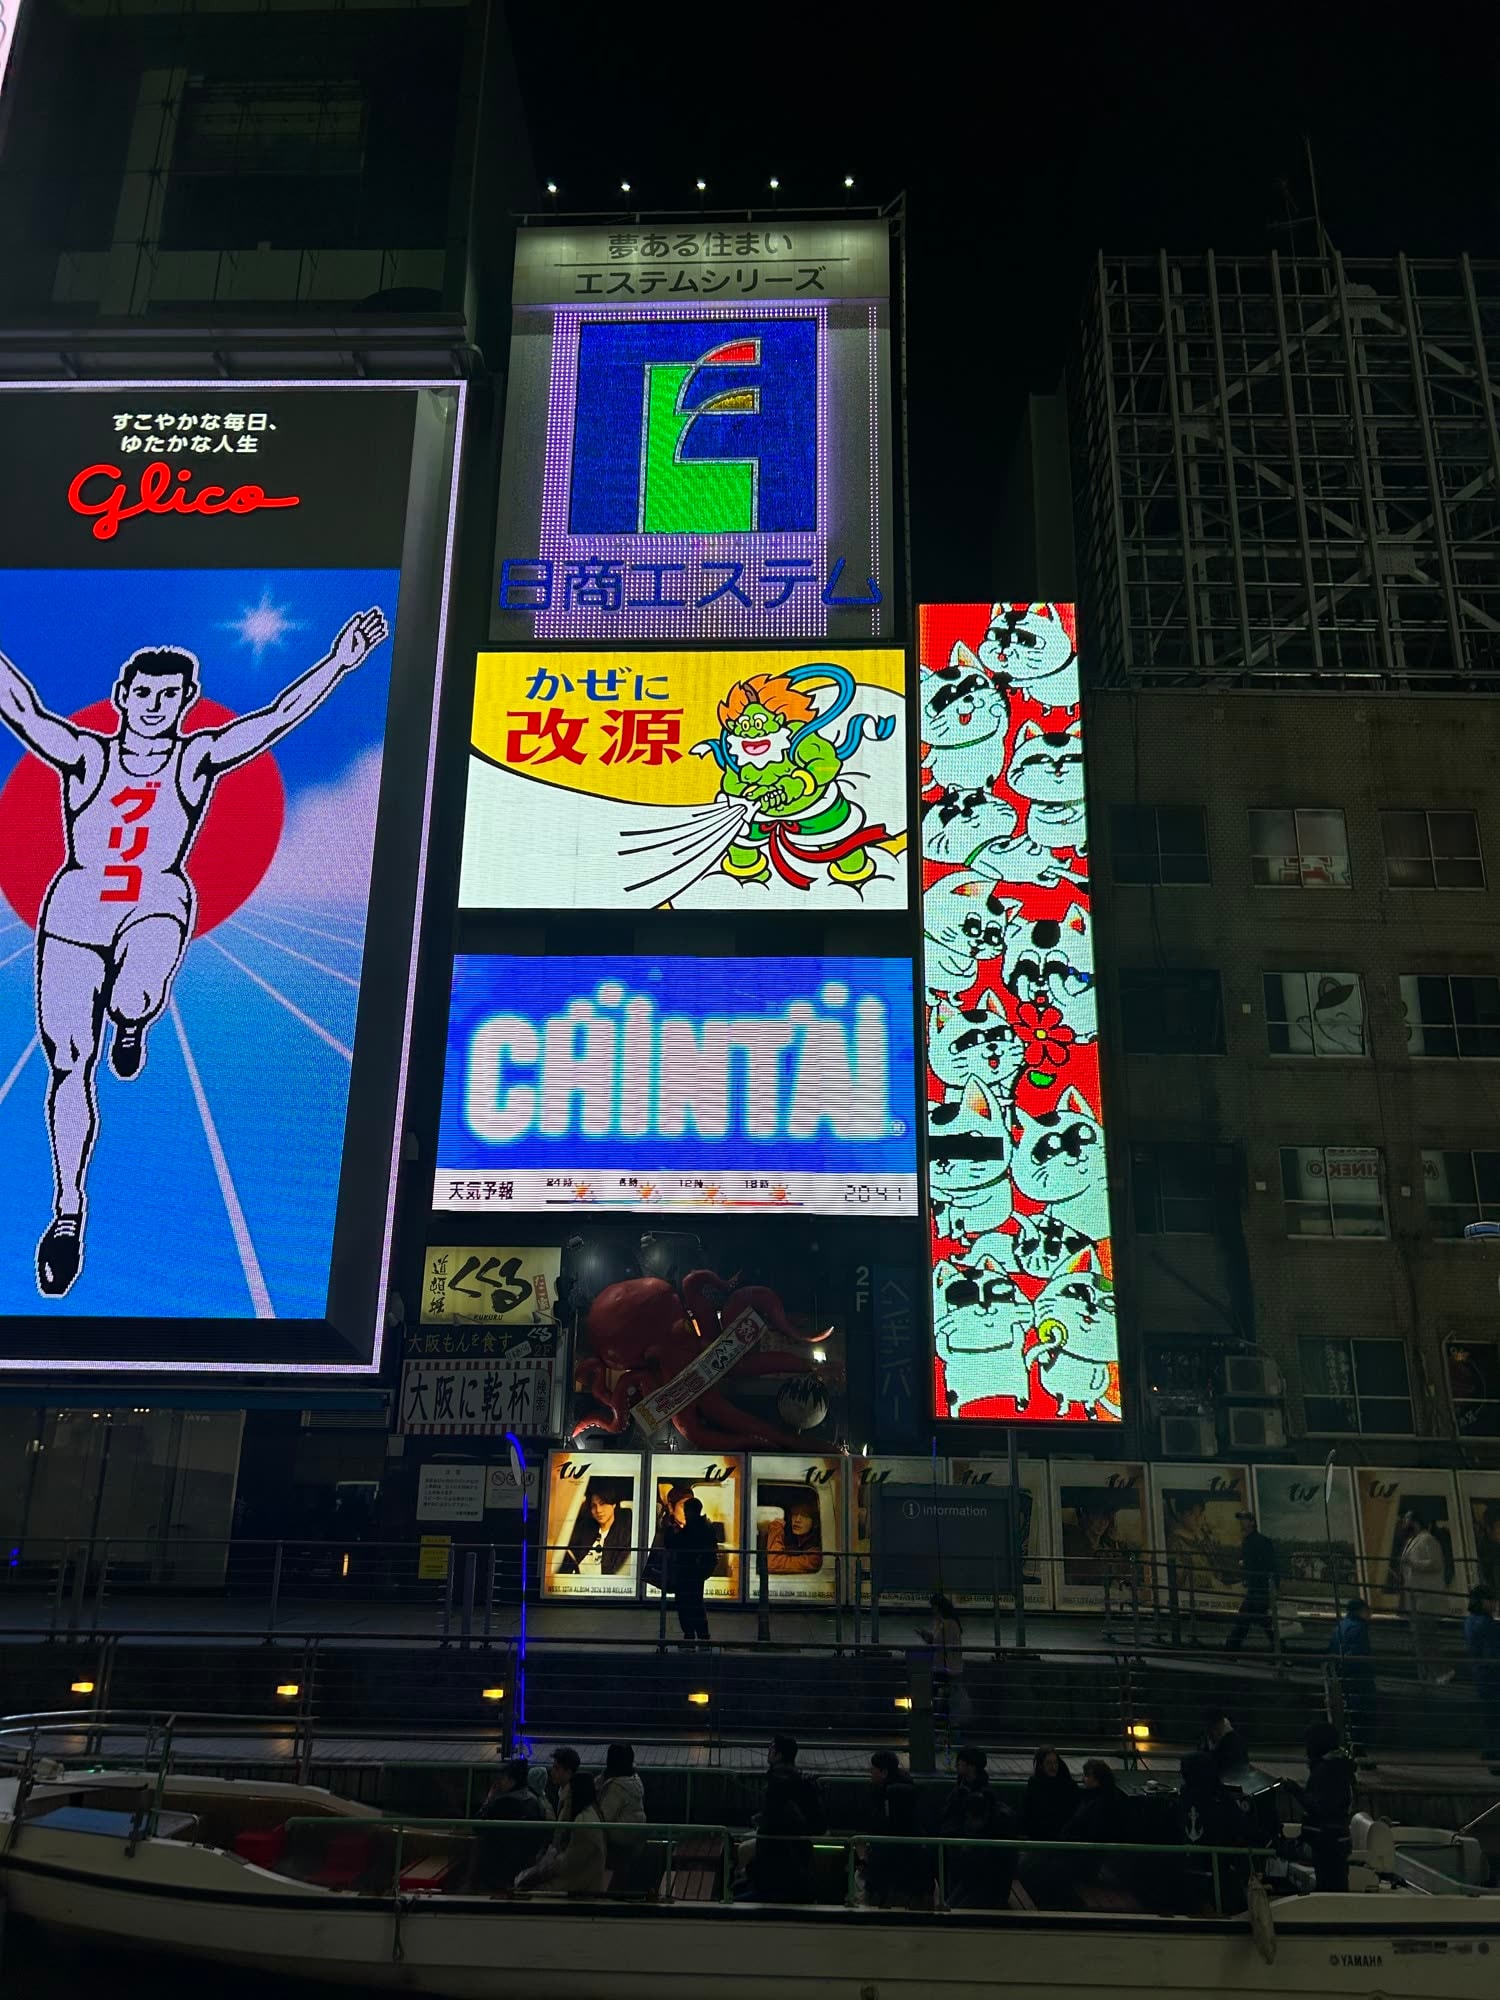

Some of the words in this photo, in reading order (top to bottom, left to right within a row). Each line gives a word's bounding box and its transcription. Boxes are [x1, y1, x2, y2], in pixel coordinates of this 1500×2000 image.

[607, 231, 794, 259] 夢ある住まい
[574, 265, 827, 295] エステムシリーズ
[112, 412, 277, 432] すこやかな毎日、
[120, 434, 259, 453] ゆたかな人生
[499, 555, 884, 612] 日商エステム
[526, 667, 670, 701] かぜに
[506, 707, 684, 766] 改源
[99, 781, 162, 902] グリコ
[448, 1181, 514, 1200] 天気予報
[428, 1254, 449, 1315] 道頓堀
[448, 1256, 533, 1313] くくる
[408, 1330, 512, 1354] 大阪もんを食す
[407, 1371, 530, 1422] 大阪に乾杯
[612, 1587, 632, 1595] RELEASE
[1341, 1955, 1383, 1967] YAMAHA
